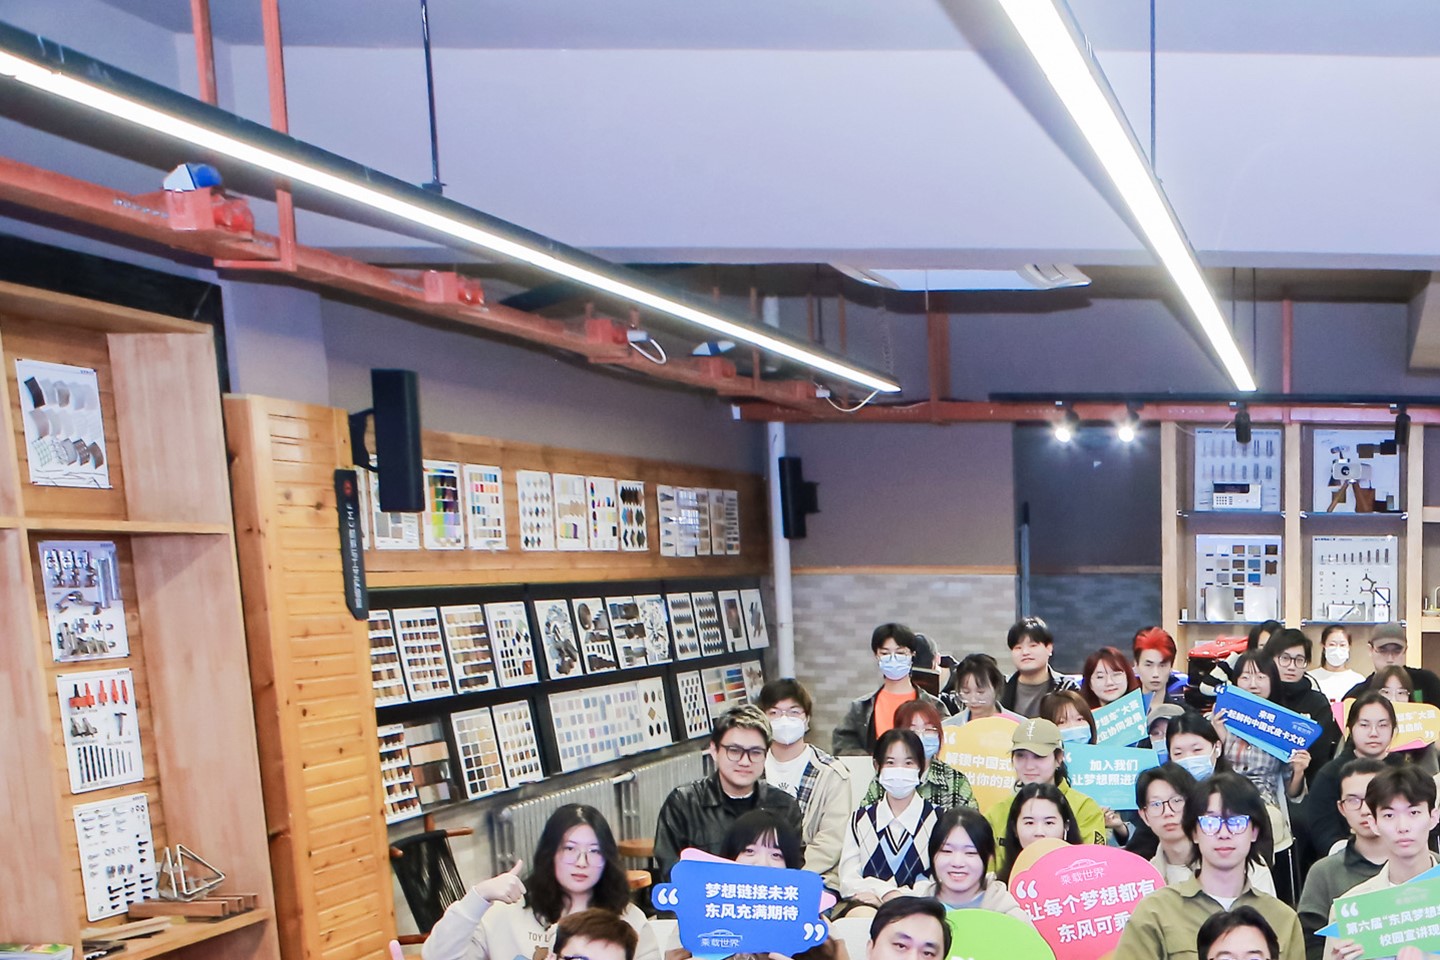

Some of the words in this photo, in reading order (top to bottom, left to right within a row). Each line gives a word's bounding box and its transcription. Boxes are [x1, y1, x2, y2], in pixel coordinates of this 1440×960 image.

[1090, 760, 1138, 771] 加入我们
[705, 883, 799, 901] 梦想链接未来
[705, 903, 799, 921] 东风充满期待
